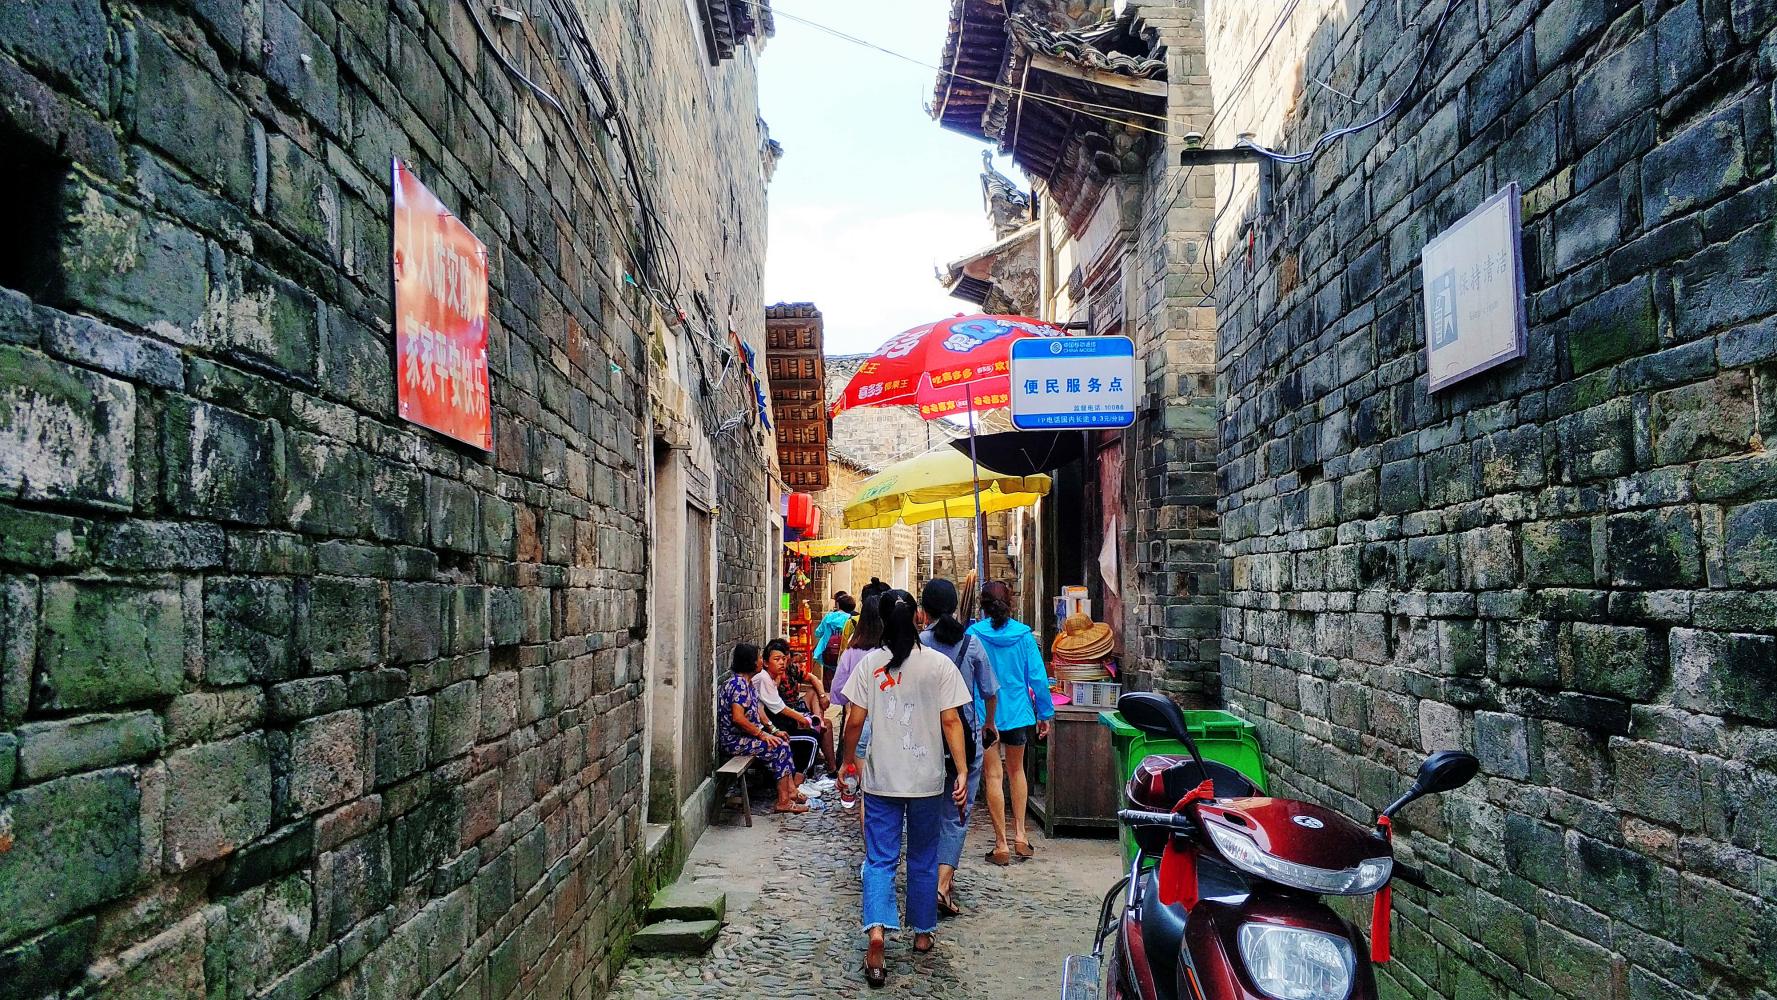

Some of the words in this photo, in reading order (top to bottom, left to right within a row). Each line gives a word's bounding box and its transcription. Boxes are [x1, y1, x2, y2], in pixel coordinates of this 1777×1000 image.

[1459, 247, 1507, 295] 保持清洁
[404, 311, 487, 419] 家家平安快乐
[1024, 377, 1123, 394] 便民服务点
